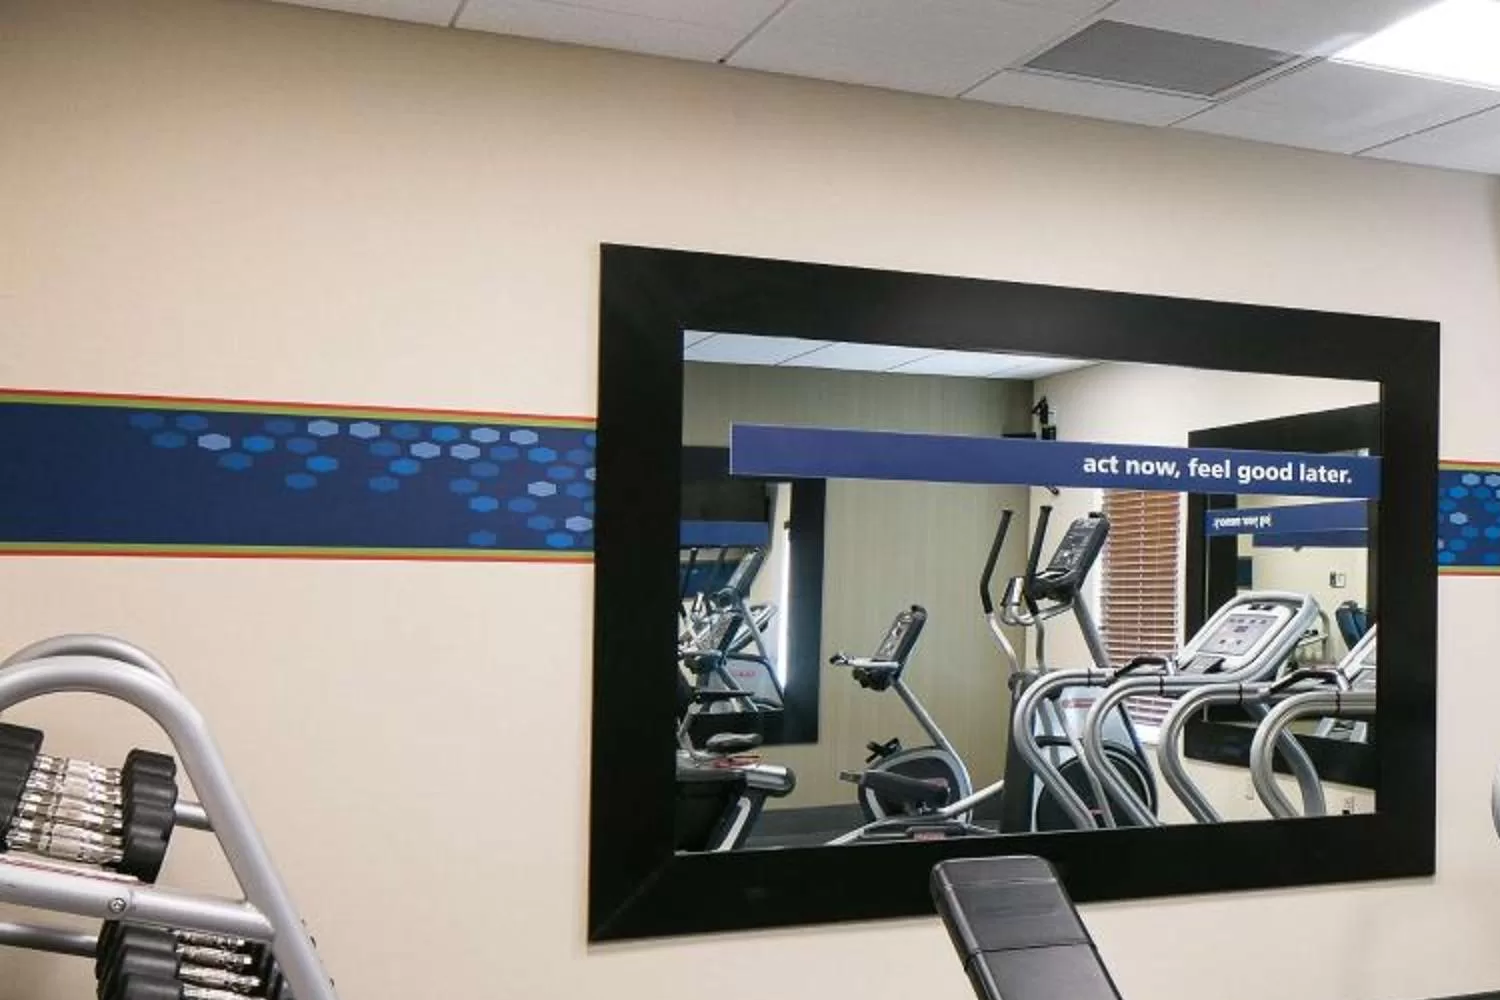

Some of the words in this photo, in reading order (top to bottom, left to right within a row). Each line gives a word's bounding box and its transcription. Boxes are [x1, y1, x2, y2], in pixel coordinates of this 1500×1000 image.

[1083, 455, 1119, 474] act
[1125, 459, 1181, 479] now,
[1188, 457, 1231, 480] feel
[1237, 462, 1293, 485] good
[1299, 463, 1353, 485] later.
